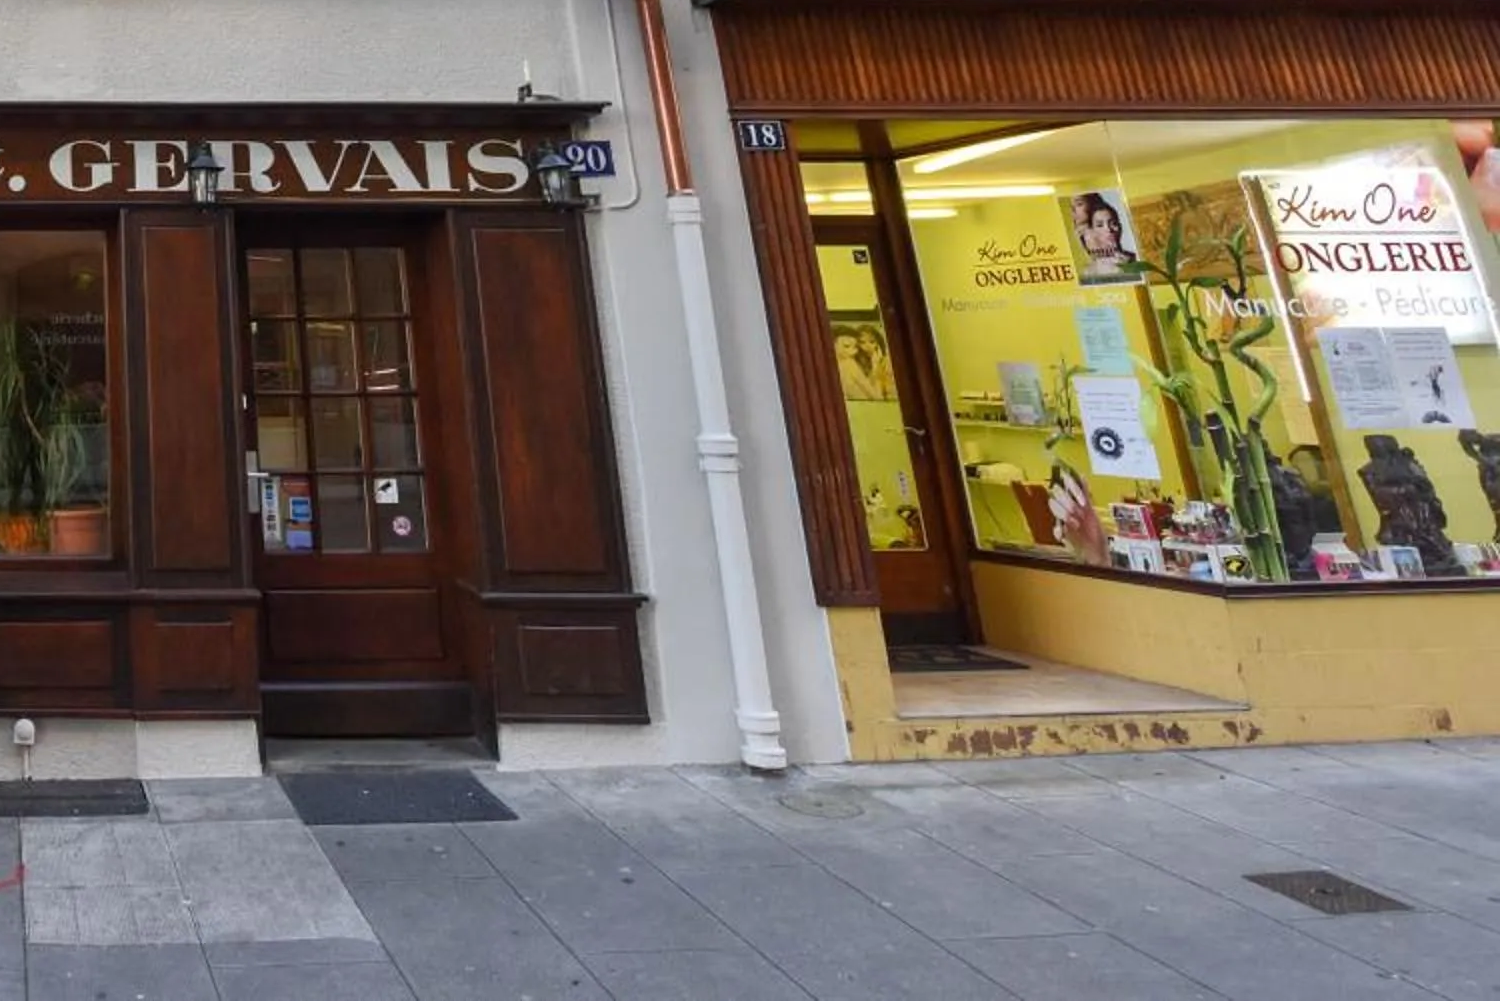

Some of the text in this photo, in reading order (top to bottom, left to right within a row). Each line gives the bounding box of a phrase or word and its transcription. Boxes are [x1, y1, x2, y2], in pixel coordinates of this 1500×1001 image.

[747, 124, 777, 147] 18
[49, 139, 531, 194] GERVAIS
[565, 144, 607, 173] 20
[1276, 183, 1437, 228] Kim One
[977, 234, 1058, 263] Kim One
[1275, 241, 1473, 273] ONGLERIE
[974, 264, 1075, 288] ONGLERIE
